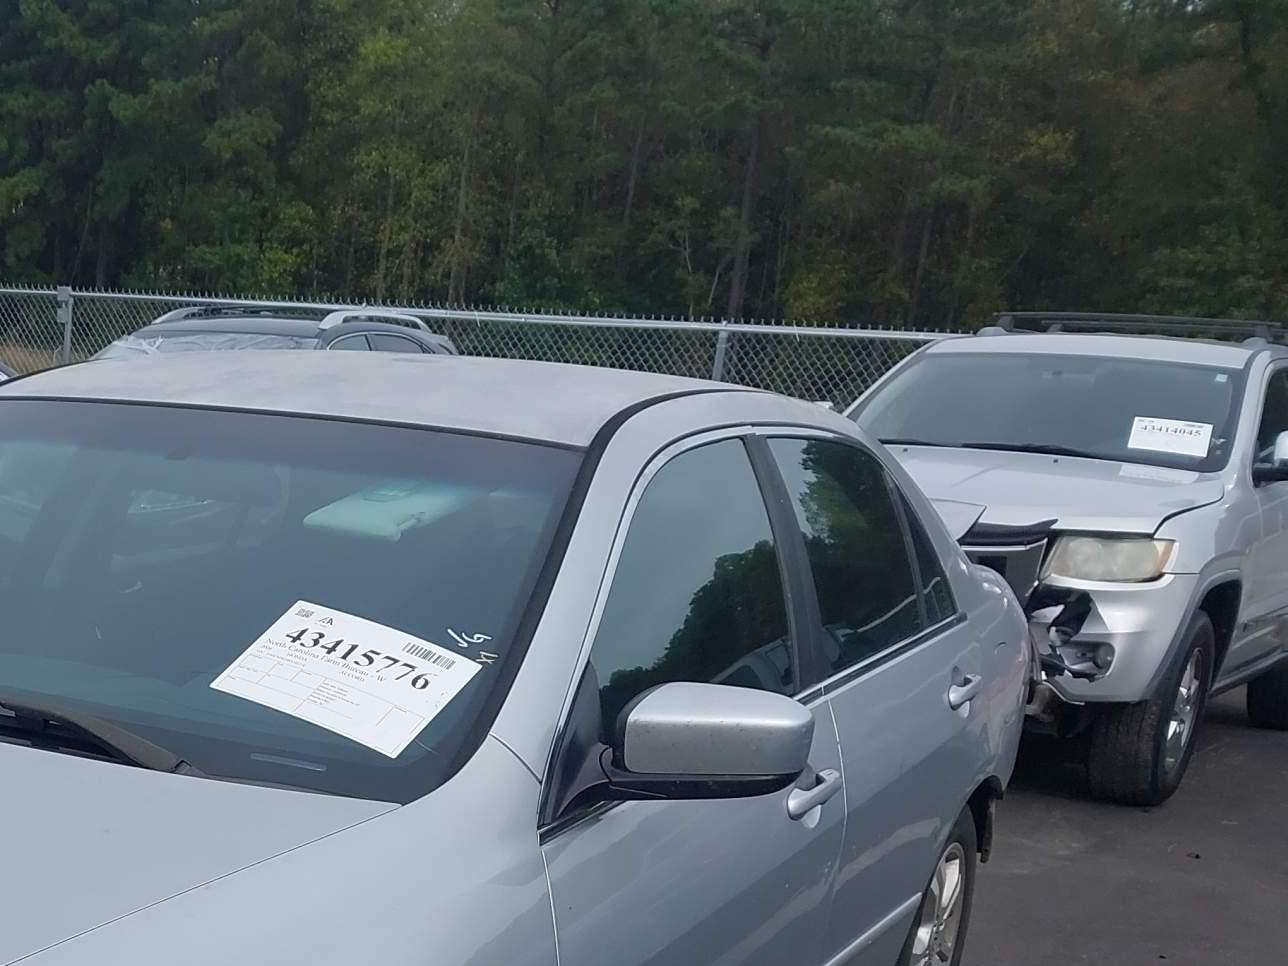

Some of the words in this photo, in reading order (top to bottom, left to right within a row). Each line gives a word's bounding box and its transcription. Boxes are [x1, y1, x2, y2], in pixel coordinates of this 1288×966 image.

[265, 638, 288, 649] North
[288, 643, 320, 659] Carolina
[320, 651, 341, 667] Farm
[342, 662, 369, 677] Bureau
[285, 628, 438, 690] 43415776
